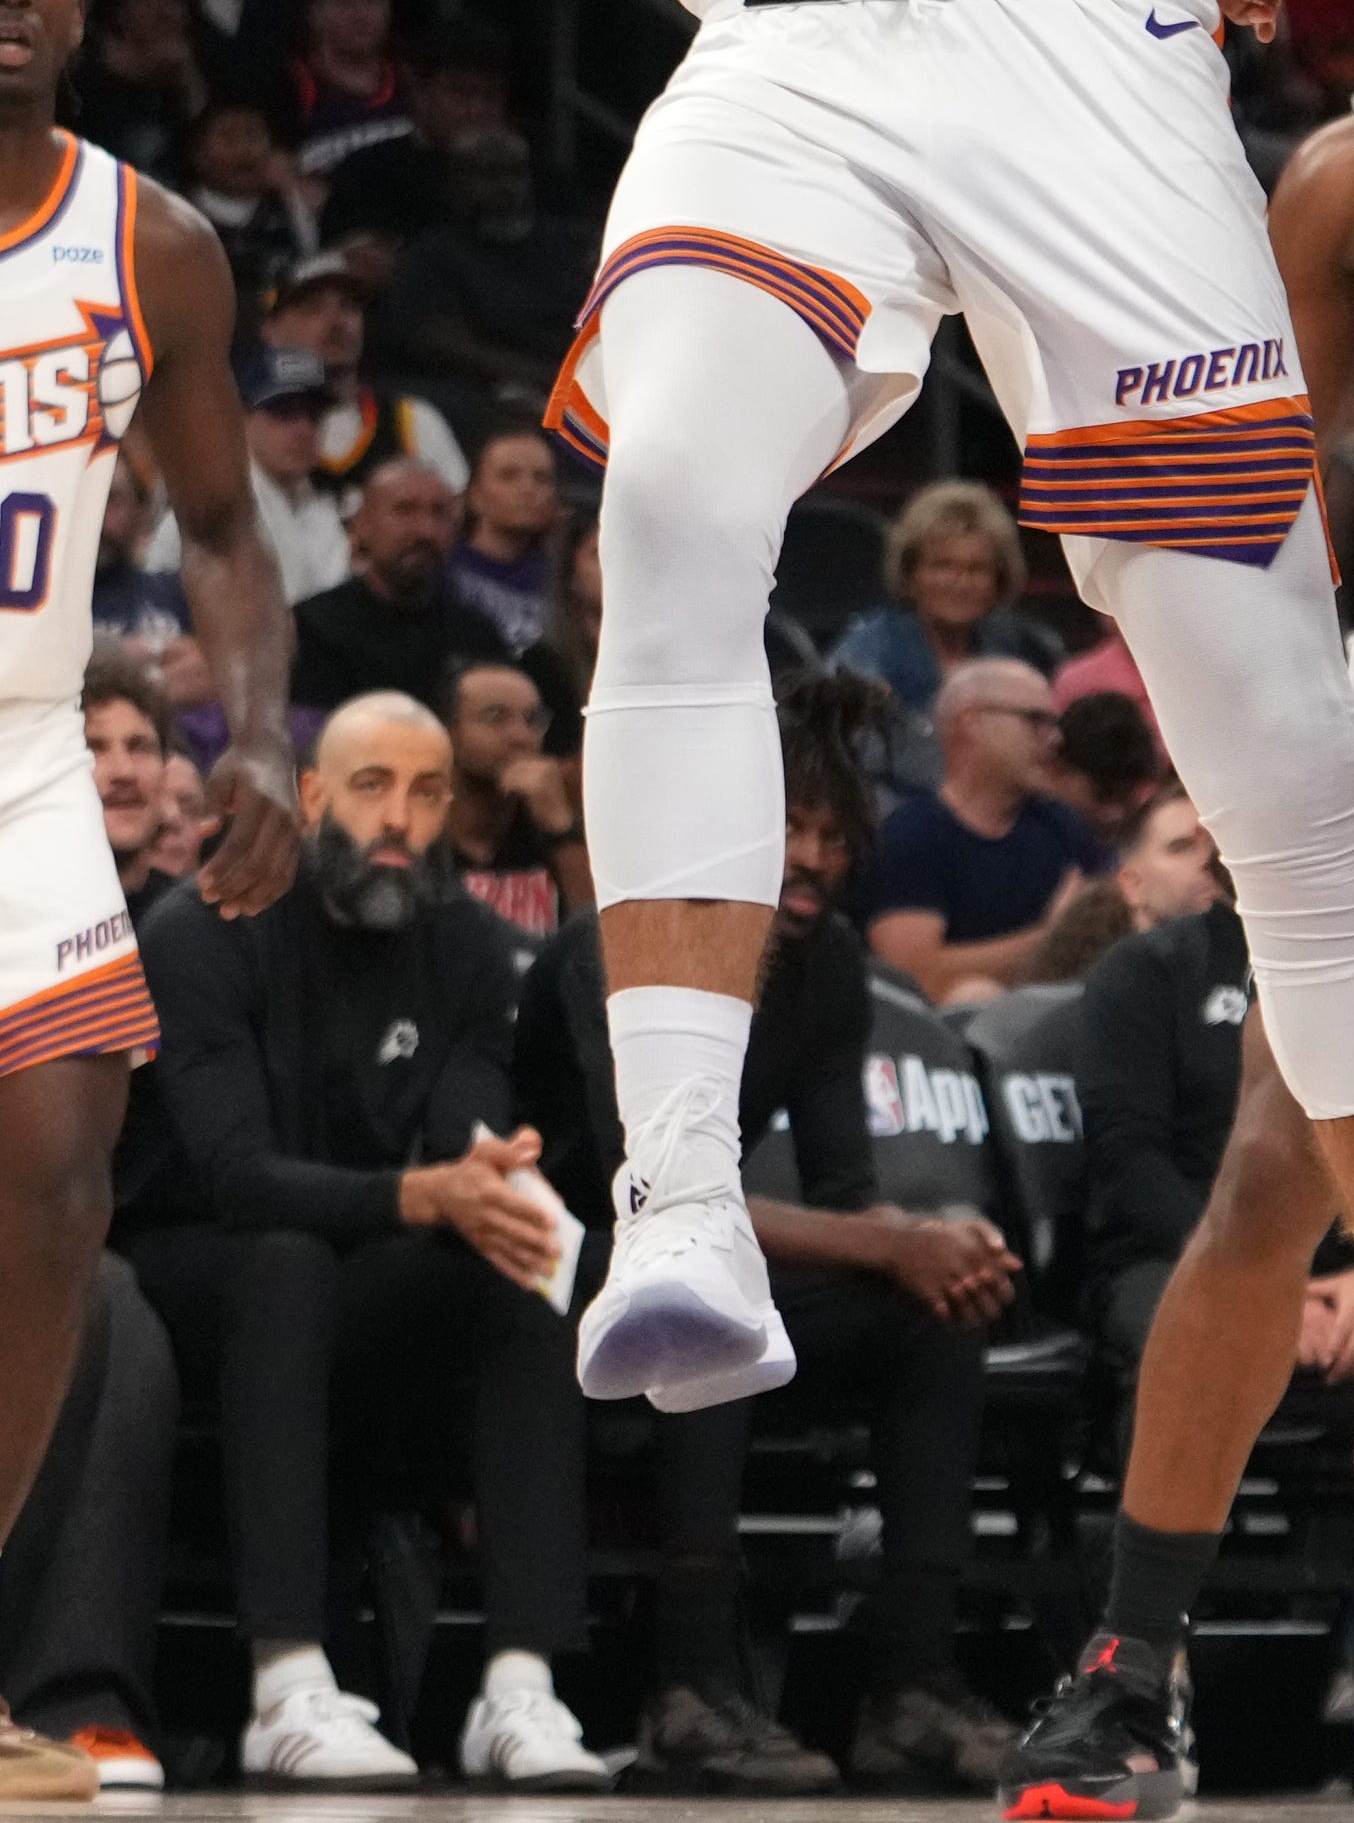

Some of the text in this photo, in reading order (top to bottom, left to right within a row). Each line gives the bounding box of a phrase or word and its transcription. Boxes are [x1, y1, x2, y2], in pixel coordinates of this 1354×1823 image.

[53, 245, 104, 266] paze
[1115, 338, 1289, 406] PHOENIX
[56, 908, 134, 972] PHOEN
